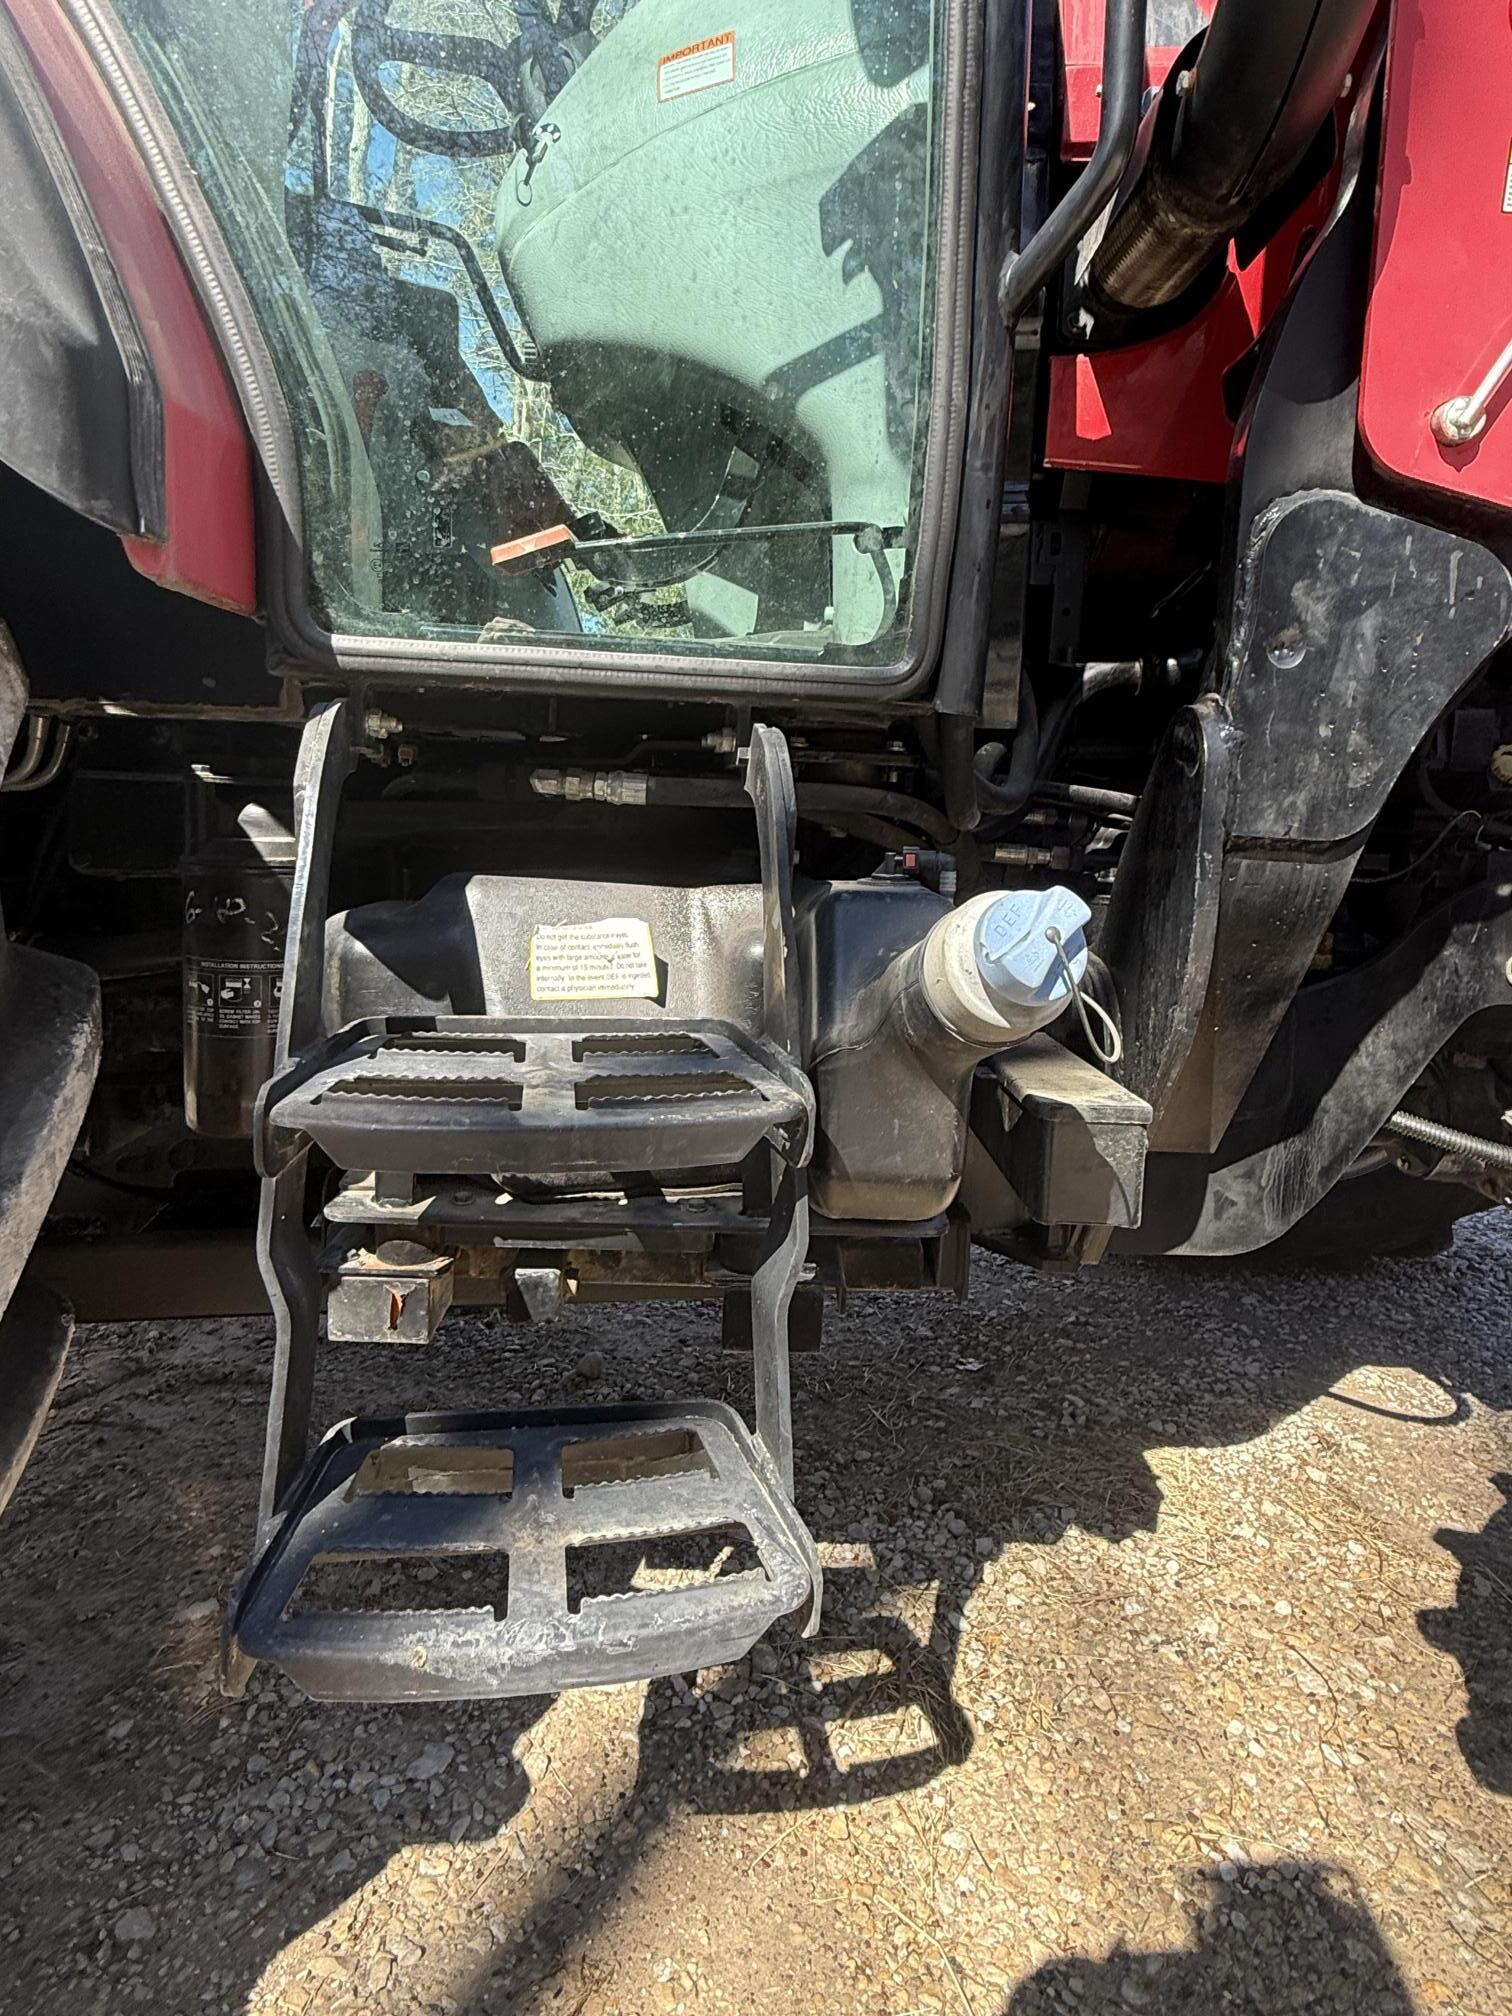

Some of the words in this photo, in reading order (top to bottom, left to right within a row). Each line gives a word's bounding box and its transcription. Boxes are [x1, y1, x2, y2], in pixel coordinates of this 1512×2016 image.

[662, 32, 733, 64] IMPORTANT
[994, 904, 1021, 938] DEF
[558, 934, 567, 942] get
[625, 941, 640, 949] flush
[536, 954, 551, 962] eyes
[552, 953, 565, 961] with
[566, 953, 582, 963] large
[580, 963, 588, 971] 15
[616, 961, 625, 970] Do
[626, 961, 634, 969] not
[635, 961, 647, 969] take
[606, 972, 619, 981] DEF
[566, 984, 596, 993] physician
